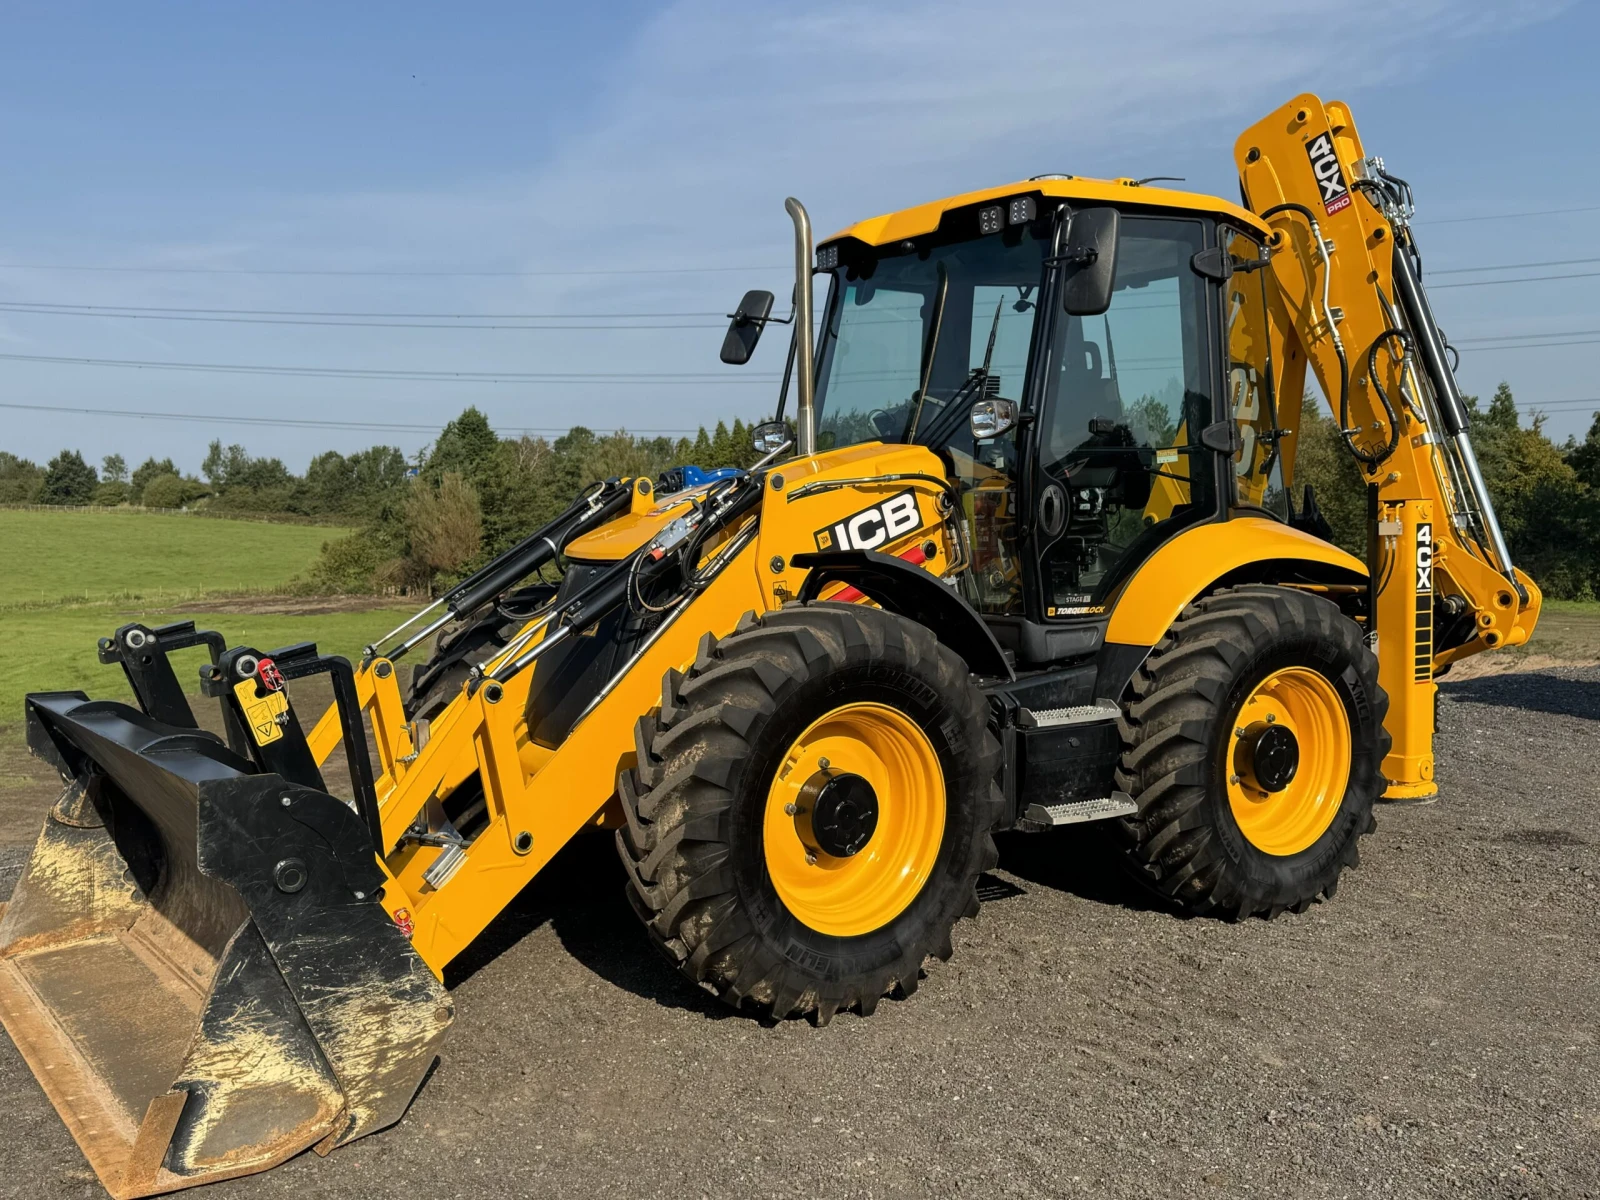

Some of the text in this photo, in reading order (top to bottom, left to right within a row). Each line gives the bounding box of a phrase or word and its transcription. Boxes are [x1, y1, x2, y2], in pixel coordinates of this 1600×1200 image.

[1309, 135, 1346, 201] 4CX
[1327, 197, 1350, 214] PRO
[835, 493, 920, 550] JCB
[1416, 525, 1431, 588] 4CX
[1349, 678, 1371, 725] XMCL
